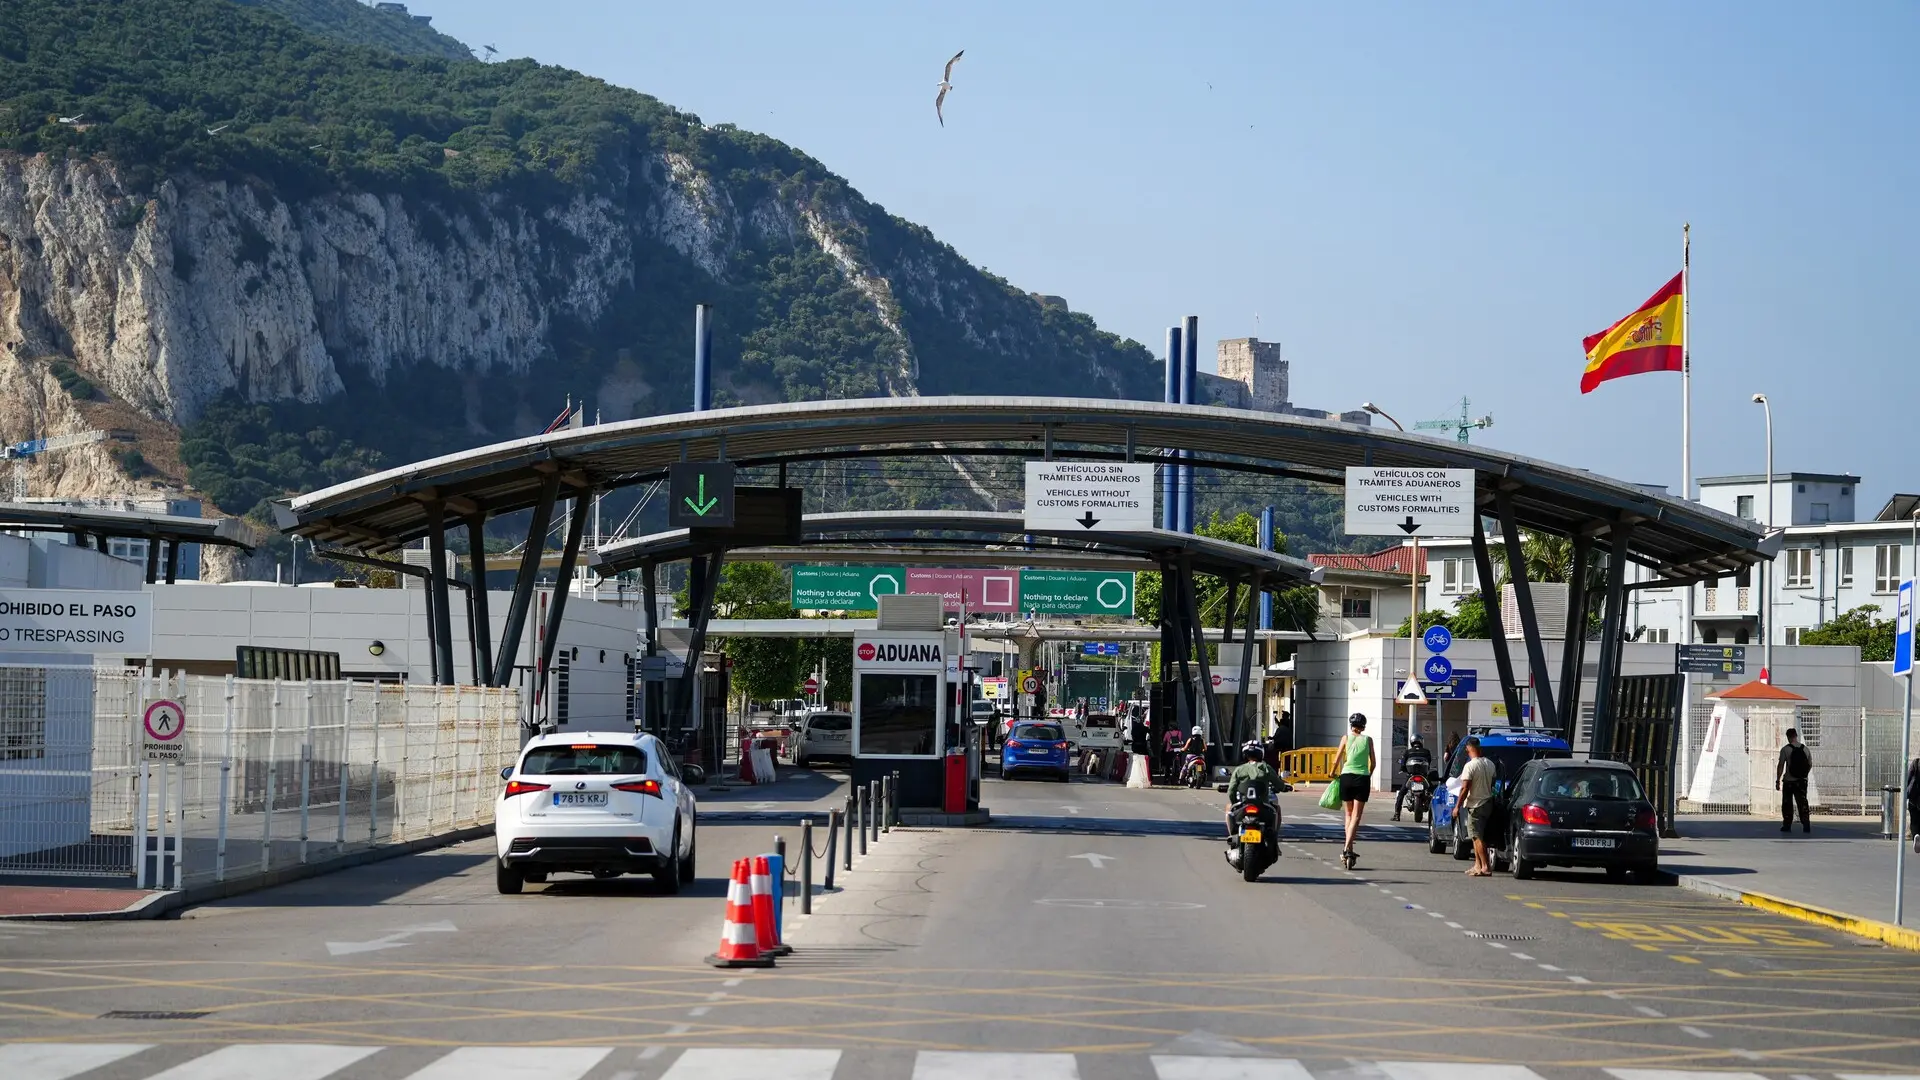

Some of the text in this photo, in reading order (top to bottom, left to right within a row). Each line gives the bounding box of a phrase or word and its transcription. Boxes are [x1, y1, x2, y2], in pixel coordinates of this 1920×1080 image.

[1056, 464, 1106, 473] VEHÍCULOS
[1038, 473, 1082, 482] TRÁMITES
[1374, 469, 1424, 478] VEHÍCULOS
[1358, 478, 1403, 487] TRÁMITES
[796, 589, 824, 597] Nothing
[1024, 594, 1052, 602] Nothing
[70, 604, 88, 616] EL
[94, 604, 136, 617] PASO
[14, 628, 124, 643] TRESPASSING
[876, 644, 942, 662] ADUANA
[1026, 680, 1036, 689] 10
[562, 794, 605, 803] 7815 KRJ
[1596, 922, 1833, 948] BUS
